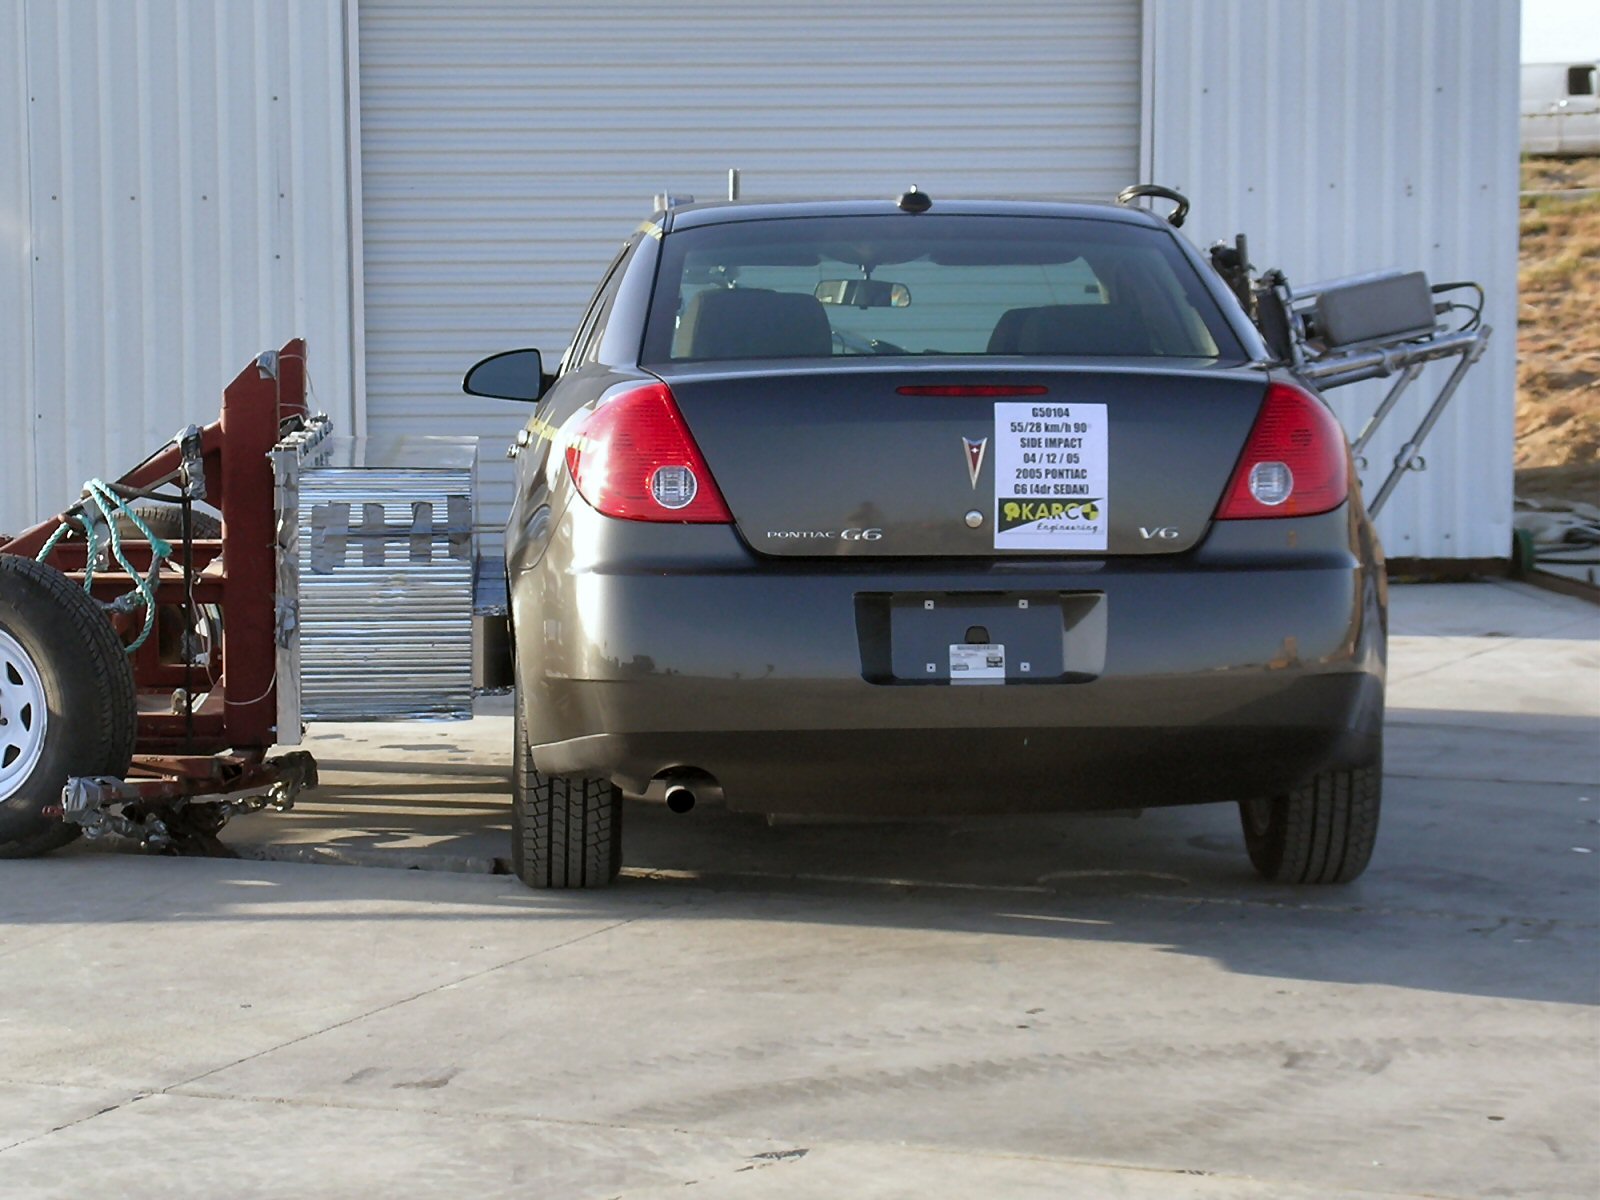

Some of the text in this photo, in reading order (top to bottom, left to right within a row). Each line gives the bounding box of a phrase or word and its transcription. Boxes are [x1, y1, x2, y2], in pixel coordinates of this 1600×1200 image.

[1010, 422, 1042, 433] 55/28
[1044, 422, 1072, 433] km/h
[1020, 437, 1083, 449] SIDE IMPACT
[1016, 468, 1087, 480] 2005 PONTIAC
[1014, 483, 1089, 496] G6 (4dr SEDAN)
[1037, 522, 1098, 533] Engineering
[1138, 526, 1179, 540] V6
[766, 527, 883, 541] PONTIAC G6
